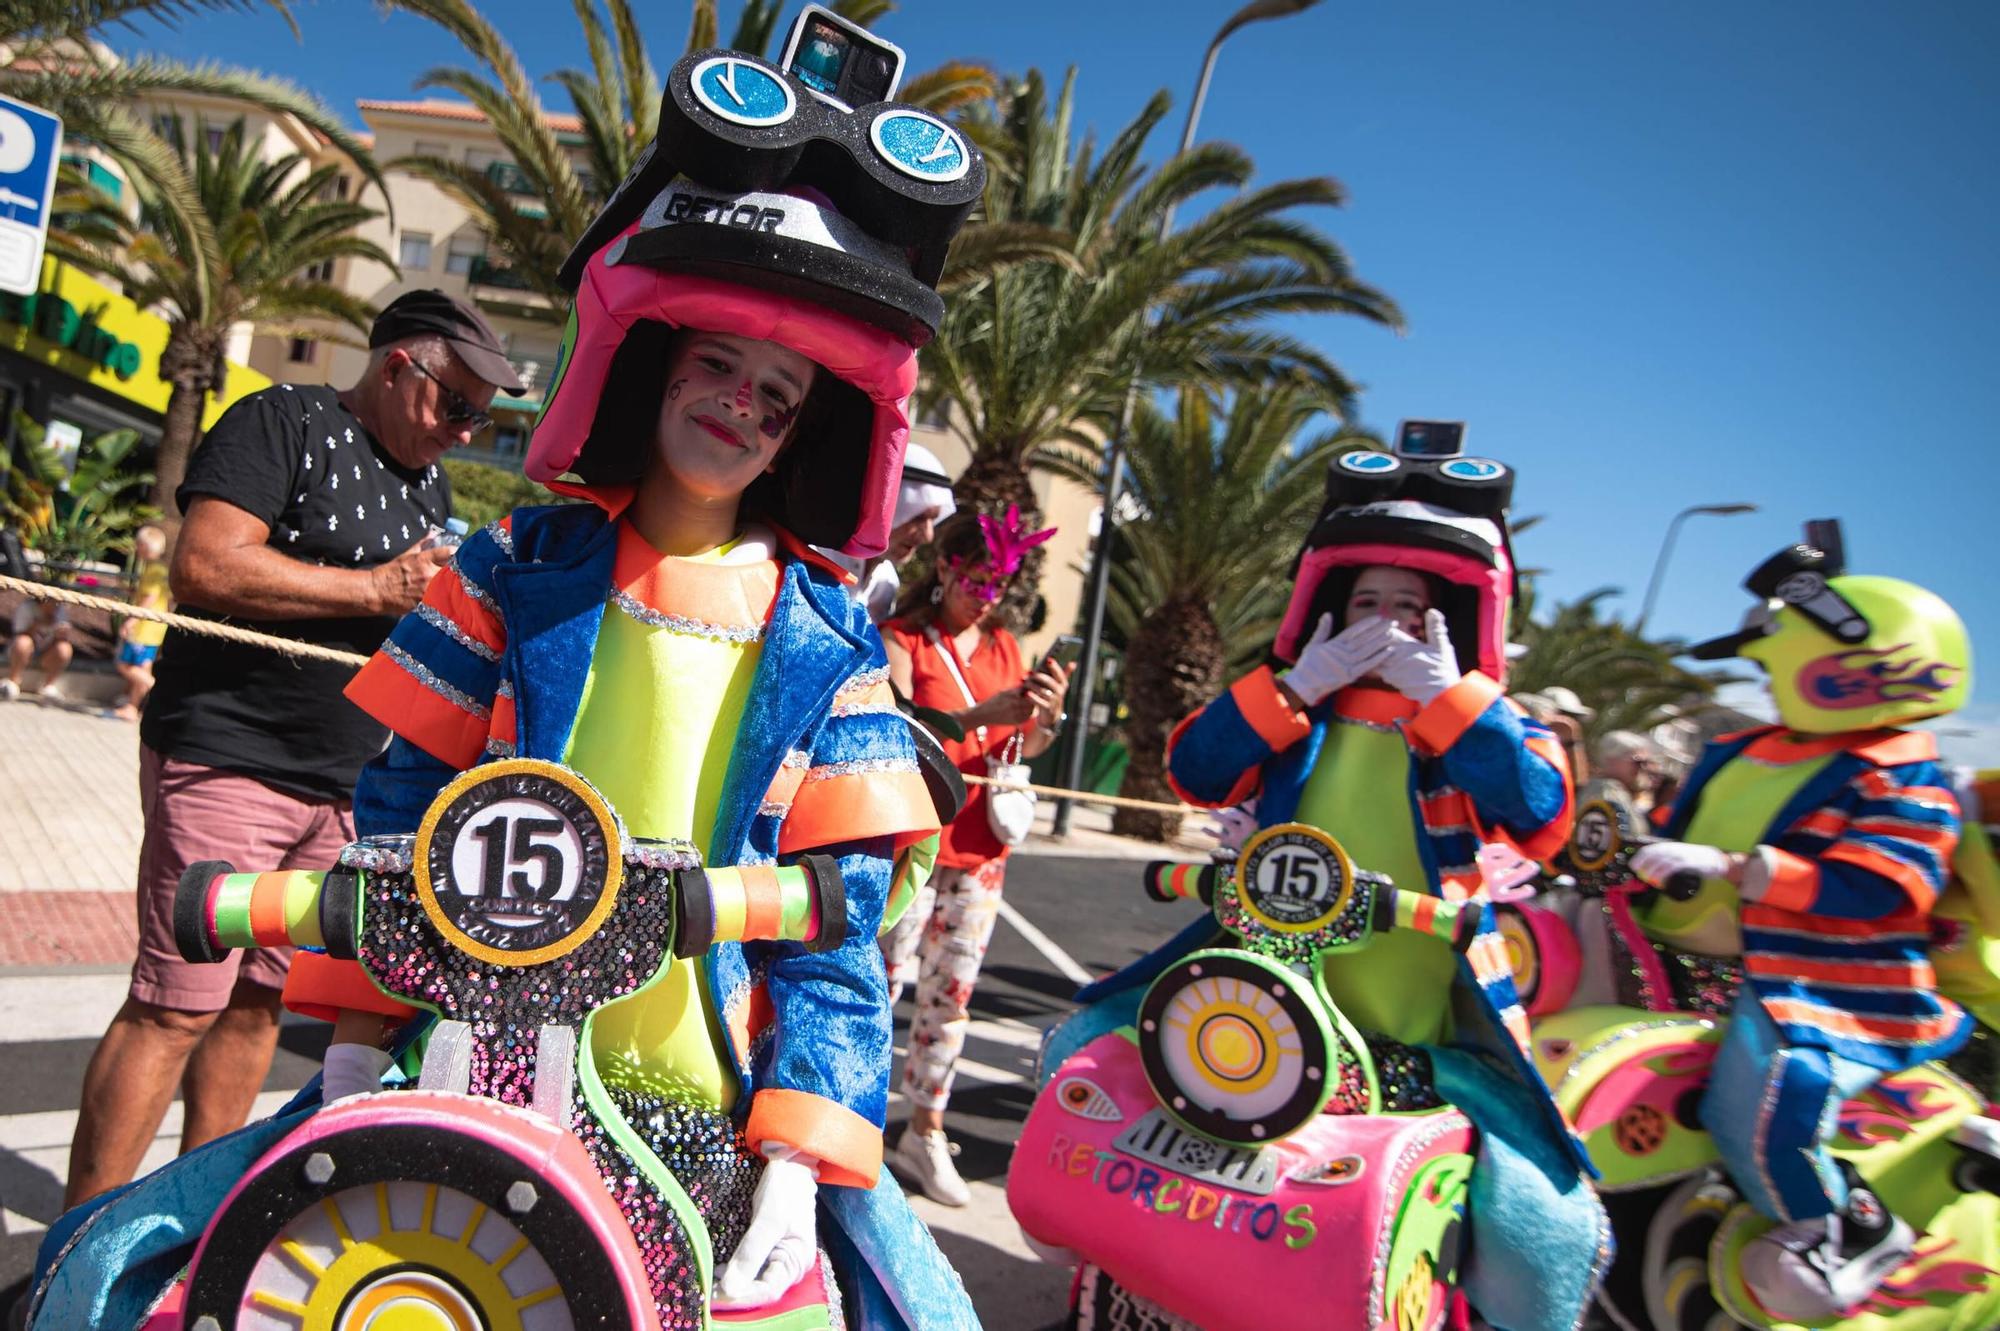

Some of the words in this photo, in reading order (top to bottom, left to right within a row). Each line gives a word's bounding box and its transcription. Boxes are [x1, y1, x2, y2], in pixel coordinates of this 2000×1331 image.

[663, 193, 785, 234] RETOR
[471, 816, 564, 901] 15
[575, 808, 606, 904] FAMILIA
[1270, 854, 1319, 899] 15
[1048, 1134, 1318, 1249] RETORCIDITOS
